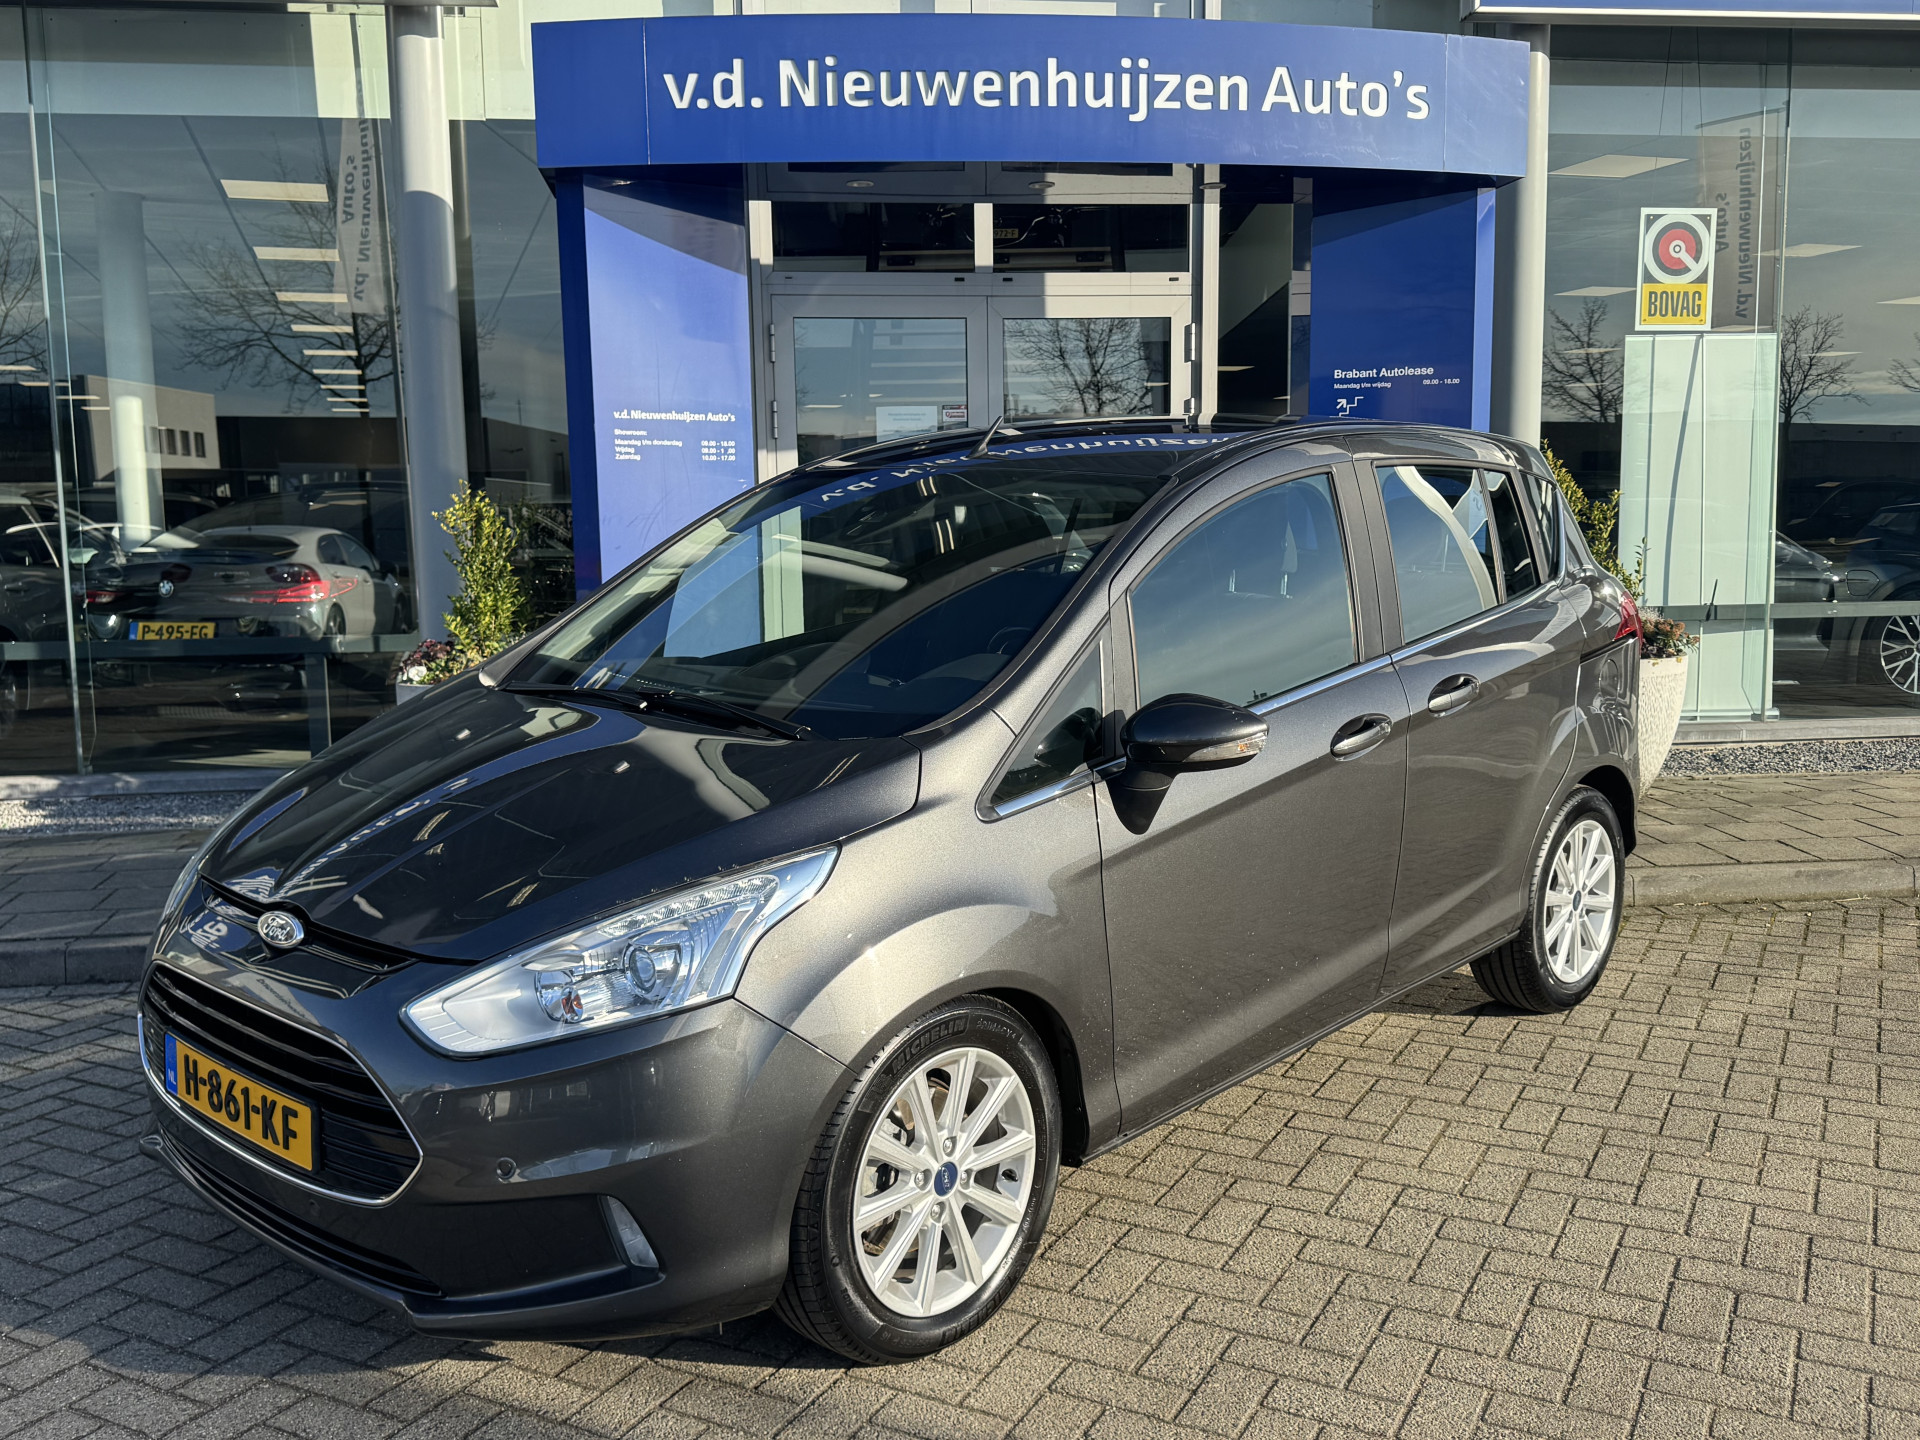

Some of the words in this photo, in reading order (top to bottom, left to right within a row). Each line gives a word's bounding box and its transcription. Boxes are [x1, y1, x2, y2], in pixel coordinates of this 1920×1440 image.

[663, 57, 764, 110] v.d.
[779, 55, 1248, 122] Nieuwenhuijzen
[1261, 66, 1431, 120] Auto's
[1647, 290, 1702, 318] BOVAG
[1334, 368, 1377, 379] Brabant
[1379, 366, 1434, 378] Autolease
[613, 409, 630, 419] v.d.
[630, 410, 705, 422] Nieuwenhuijzen
[706, 412, 736, 421] Auto's
[263, 915, 291, 941] Ford
[892, 1018, 966, 1075] MICHELIN
[168, 1068, 177, 1086] NL
[183, 1053, 299, 1151] H-861-KF
